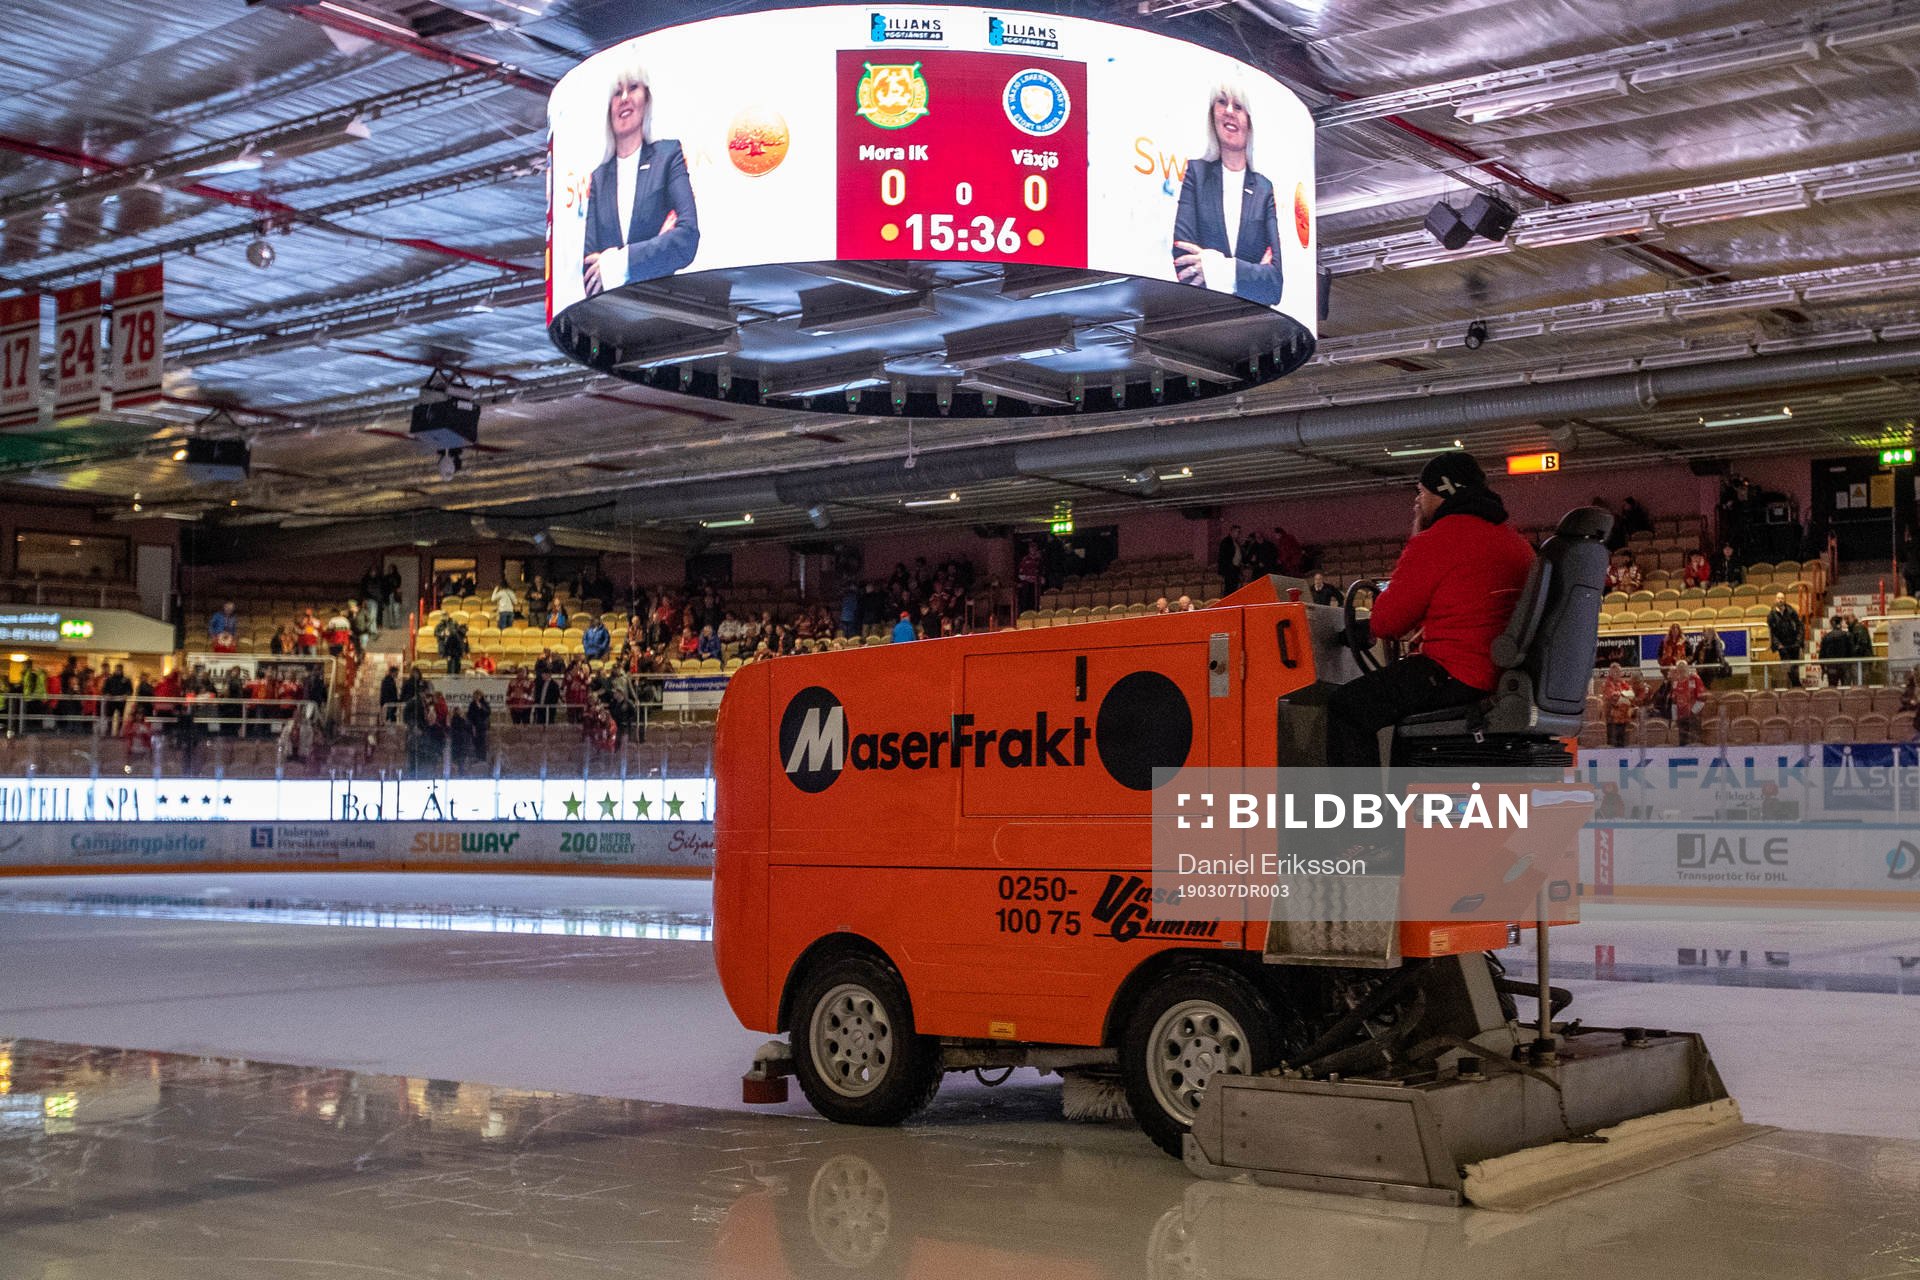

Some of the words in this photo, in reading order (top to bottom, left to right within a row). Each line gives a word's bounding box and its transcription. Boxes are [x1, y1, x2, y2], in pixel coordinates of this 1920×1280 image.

[859, 145, 908, 161] Mora
[909, 145, 928, 160] IK
[1011, 149, 1059, 170] Växjö
[881, 169, 906, 206] 0
[956, 182, 972, 205] 0
[1024, 174, 1047, 212] 0
[905, 214, 1021, 254] 15:36
[61, 324, 95, 379] 24
[120, 311, 155, 364] 78
[3, 338, 30, 389] 17
[1545, 456, 1556, 470] B
[785, 706, 1091, 773] MaserFrakt
[1668, 755, 1818, 789] FALK
[409, 832, 520, 854] SUBWAY
[560, 832, 598, 852] 200
[1678, 835, 1788, 867] JALE
[999, 875, 1078, 902] 0250-
[1764, 872, 1788, 882] DHL
[995, 909, 1041, 935] 100
[1048, 911, 1081, 937] 75
[1111, 903, 1221, 942] Gummi
